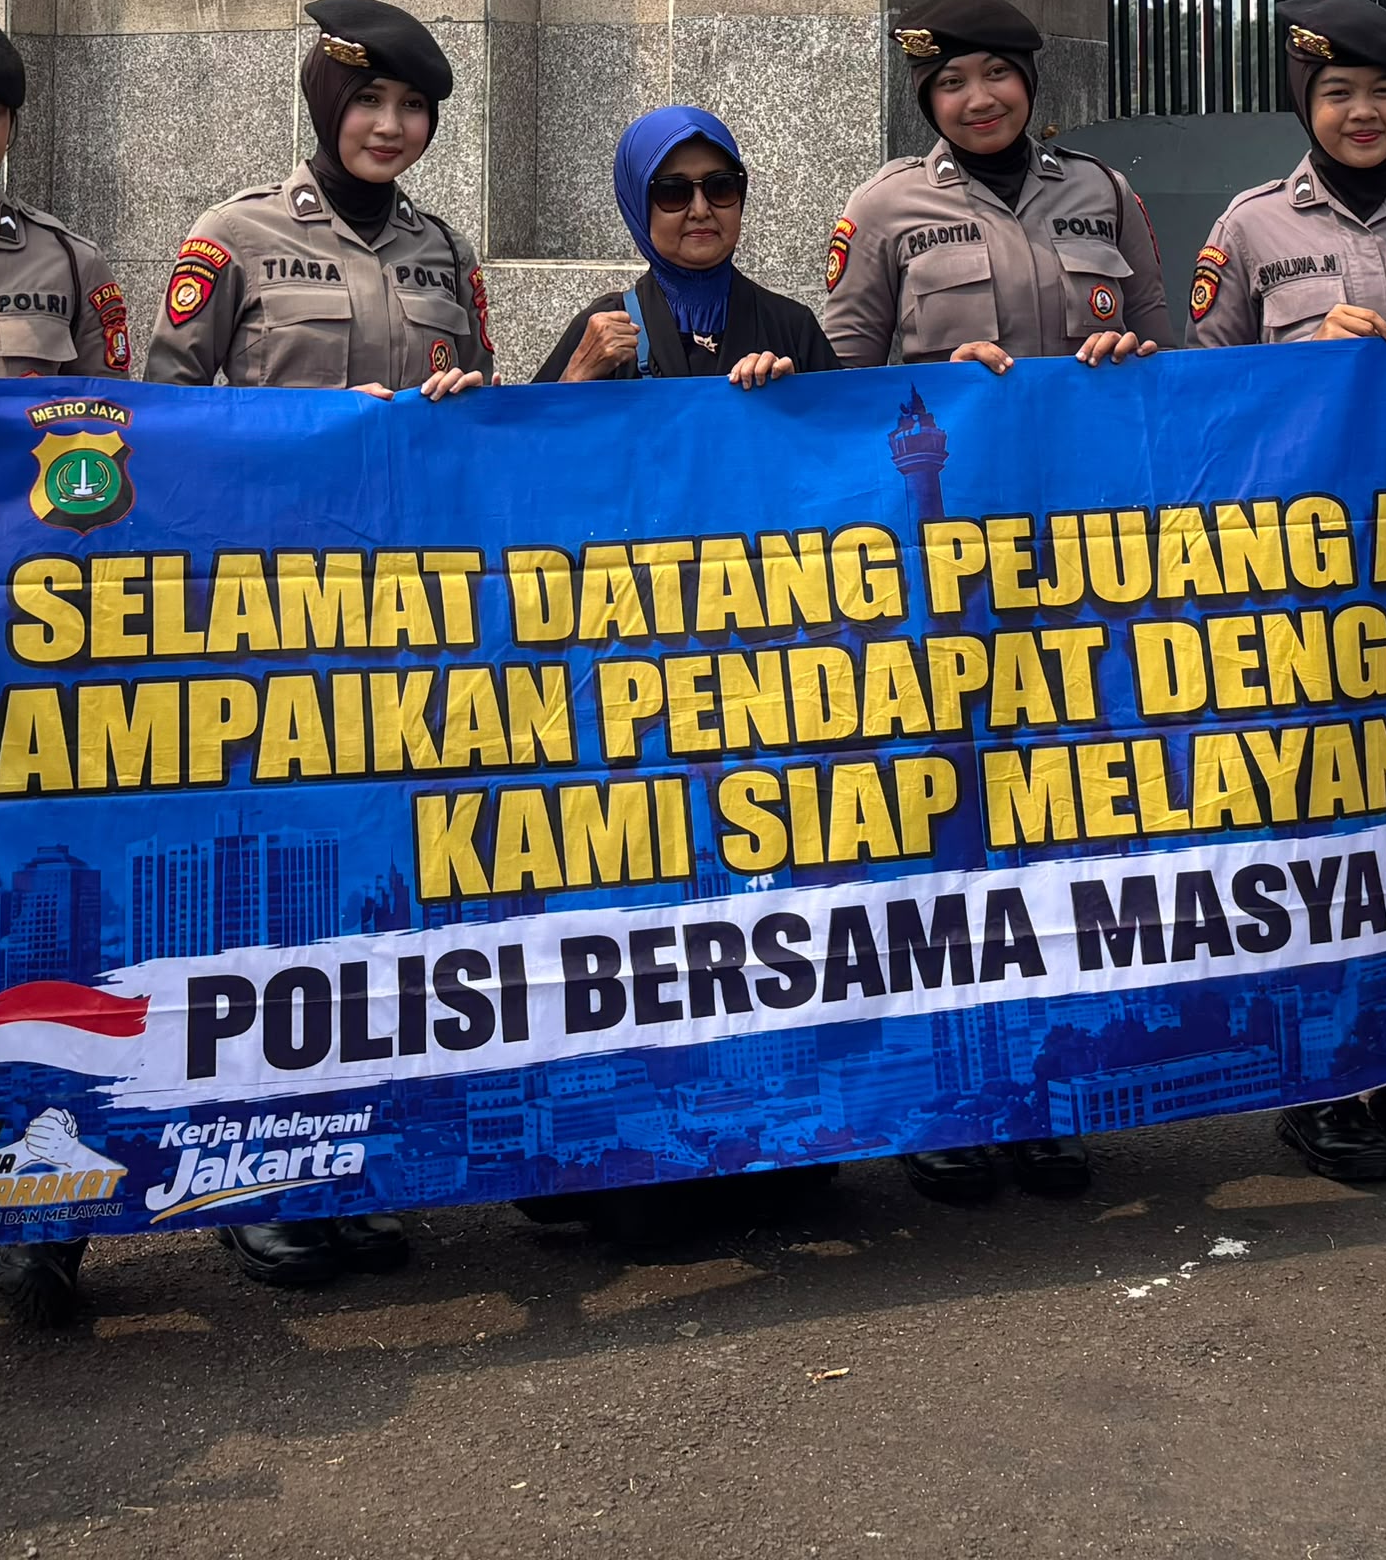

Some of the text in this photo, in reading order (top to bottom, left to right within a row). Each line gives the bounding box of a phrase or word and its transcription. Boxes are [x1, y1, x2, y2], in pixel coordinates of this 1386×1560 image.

[907, 222, 982, 255] PRADITIA
[1052, 217, 1114, 240] POLRI
[262, 258, 342, 282] TIARA
[32, 401, 125, 423] METRO JAYA
[12, 550, 481, 663] SELAMAT
[506, 526, 903, 642] DATANG
[923, 495, 1354, 614] PEJUANG
[598, 625, 1104, 759] PENDAPAT
[415, 778, 691, 900] KAMI
[718, 757, 959, 871] SIAP
[185, 942, 527, 1081] POLISI
[562, 886, 1048, 1035] BERSAMA
[158, 1104, 374, 1150] Kerja Melayani
[144, 1140, 366, 1211] Jakarta
[4, 1209, 40, 1225] DAN
[42, 1202, 124, 1221] MELAYANI
